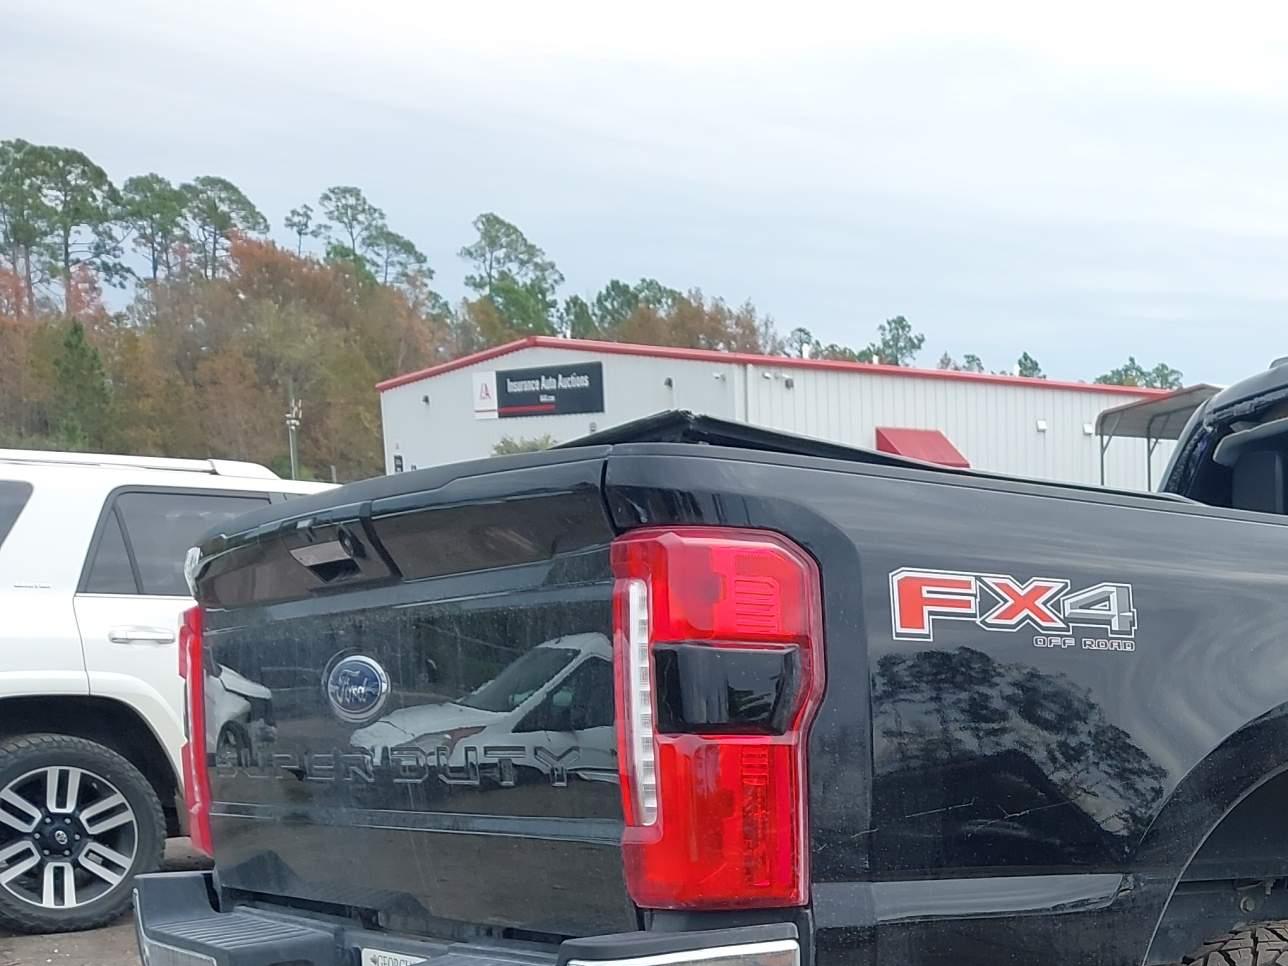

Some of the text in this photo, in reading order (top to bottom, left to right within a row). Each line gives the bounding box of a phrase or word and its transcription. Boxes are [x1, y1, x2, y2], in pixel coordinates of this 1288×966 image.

[506, 378, 540, 393] Insurance
[541, 375, 557, 390] Auto
[558, 372, 590, 389] Auctions
[888, 566, 1139, 643] FX4
[1033, 635, 1136, 652] OFF ROAD
[331, 668, 375, 705] Ford
[392, 745, 581, 787] DUTY
